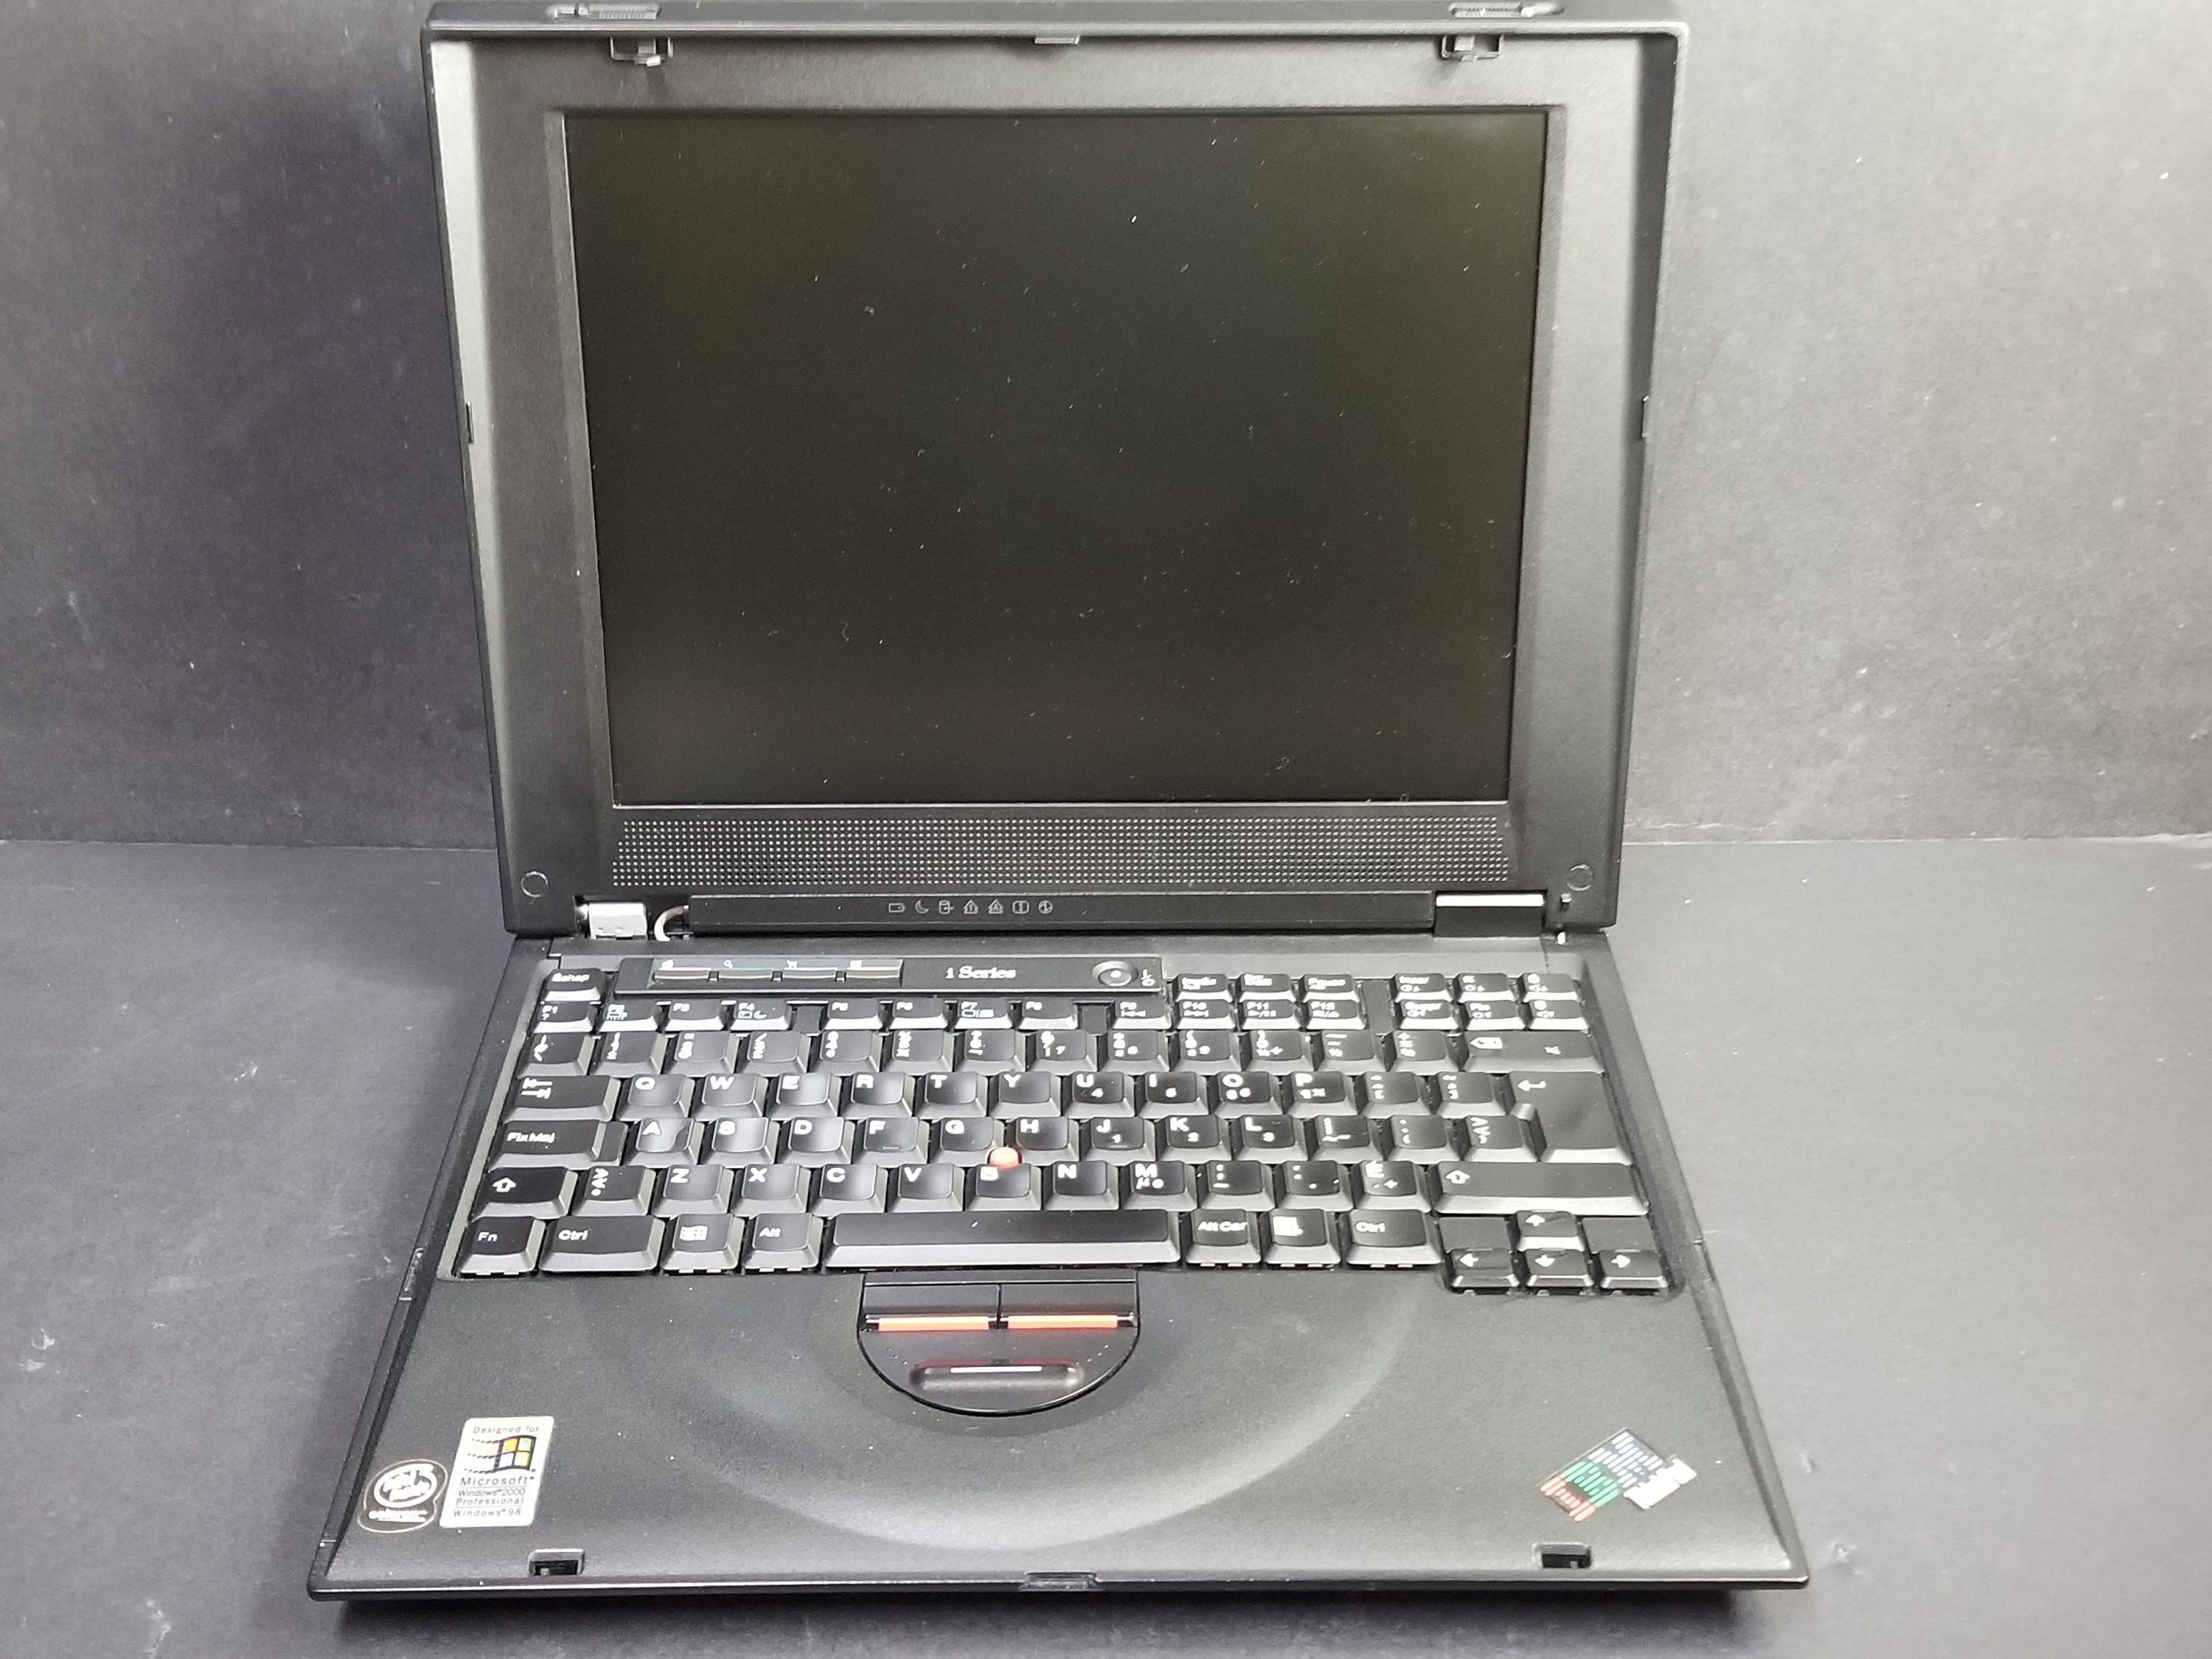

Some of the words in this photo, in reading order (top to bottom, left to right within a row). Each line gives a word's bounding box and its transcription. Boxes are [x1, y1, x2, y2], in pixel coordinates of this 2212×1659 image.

[958, 965, 1016, 978] Series
[542, 1004, 558, 1013] F1
[737, 1002, 755, 1010] F4
[961, 1001, 978, 1010] F7
[1246, 1001, 1270, 1010] F11
[635, 1076, 655, 1089] Q
[709, 1075, 734, 1089] W
[782, 1074, 800, 1089] E
[856, 1074, 874, 1088] R
[930, 1074, 947, 1088] T
[1004, 1074, 1021, 1088] Y
[1076, 1074, 1094, 1088] U
[1149, 1074, 1157, 1088] I
[1222, 1074, 1243, 1088] O
[1295, 1073, 1313, 1087] P
[641, 1121, 661, 1135] A
[717, 1121, 737, 1135] S
[793, 1120, 813, 1135] D
[869, 1120, 886, 1135] F
[945, 1119, 964, 1135] G
[1020, 1119, 1039, 1133] H
[1096, 1119, 1111, 1133] J
[1169, 1117, 1189, 1132] K
[1245, 1116, 1262, 1132] L
[669, 1168, 689, 1183] Z
[748, 1167, 768, 1183] X
[827, 1167, 846, 1183] C
[904, 1166, 922, 1182] V
[979, 1165, 999, 1181] B
[1057, 1164, 1077, 1179] N
[1135, 1163, 1158, 1179] M
[759, 1227, 782, 1237] Alt
[1197, 1221, 1219, 1231] Alt
[1355, 1222, 1385, 1233] Ctrl
[478, 1231, 498, 1242] Fn
[558, 1229, 588, 1240] Ctrl
[473, 1425, 522, 1434] Designed
[525, 1425, 540, 1433] for
[501, 1487, 526, 1496] 2000
[455, 1496, 524, 1506] Professional
[507, 1508, 522, 1517] 98
